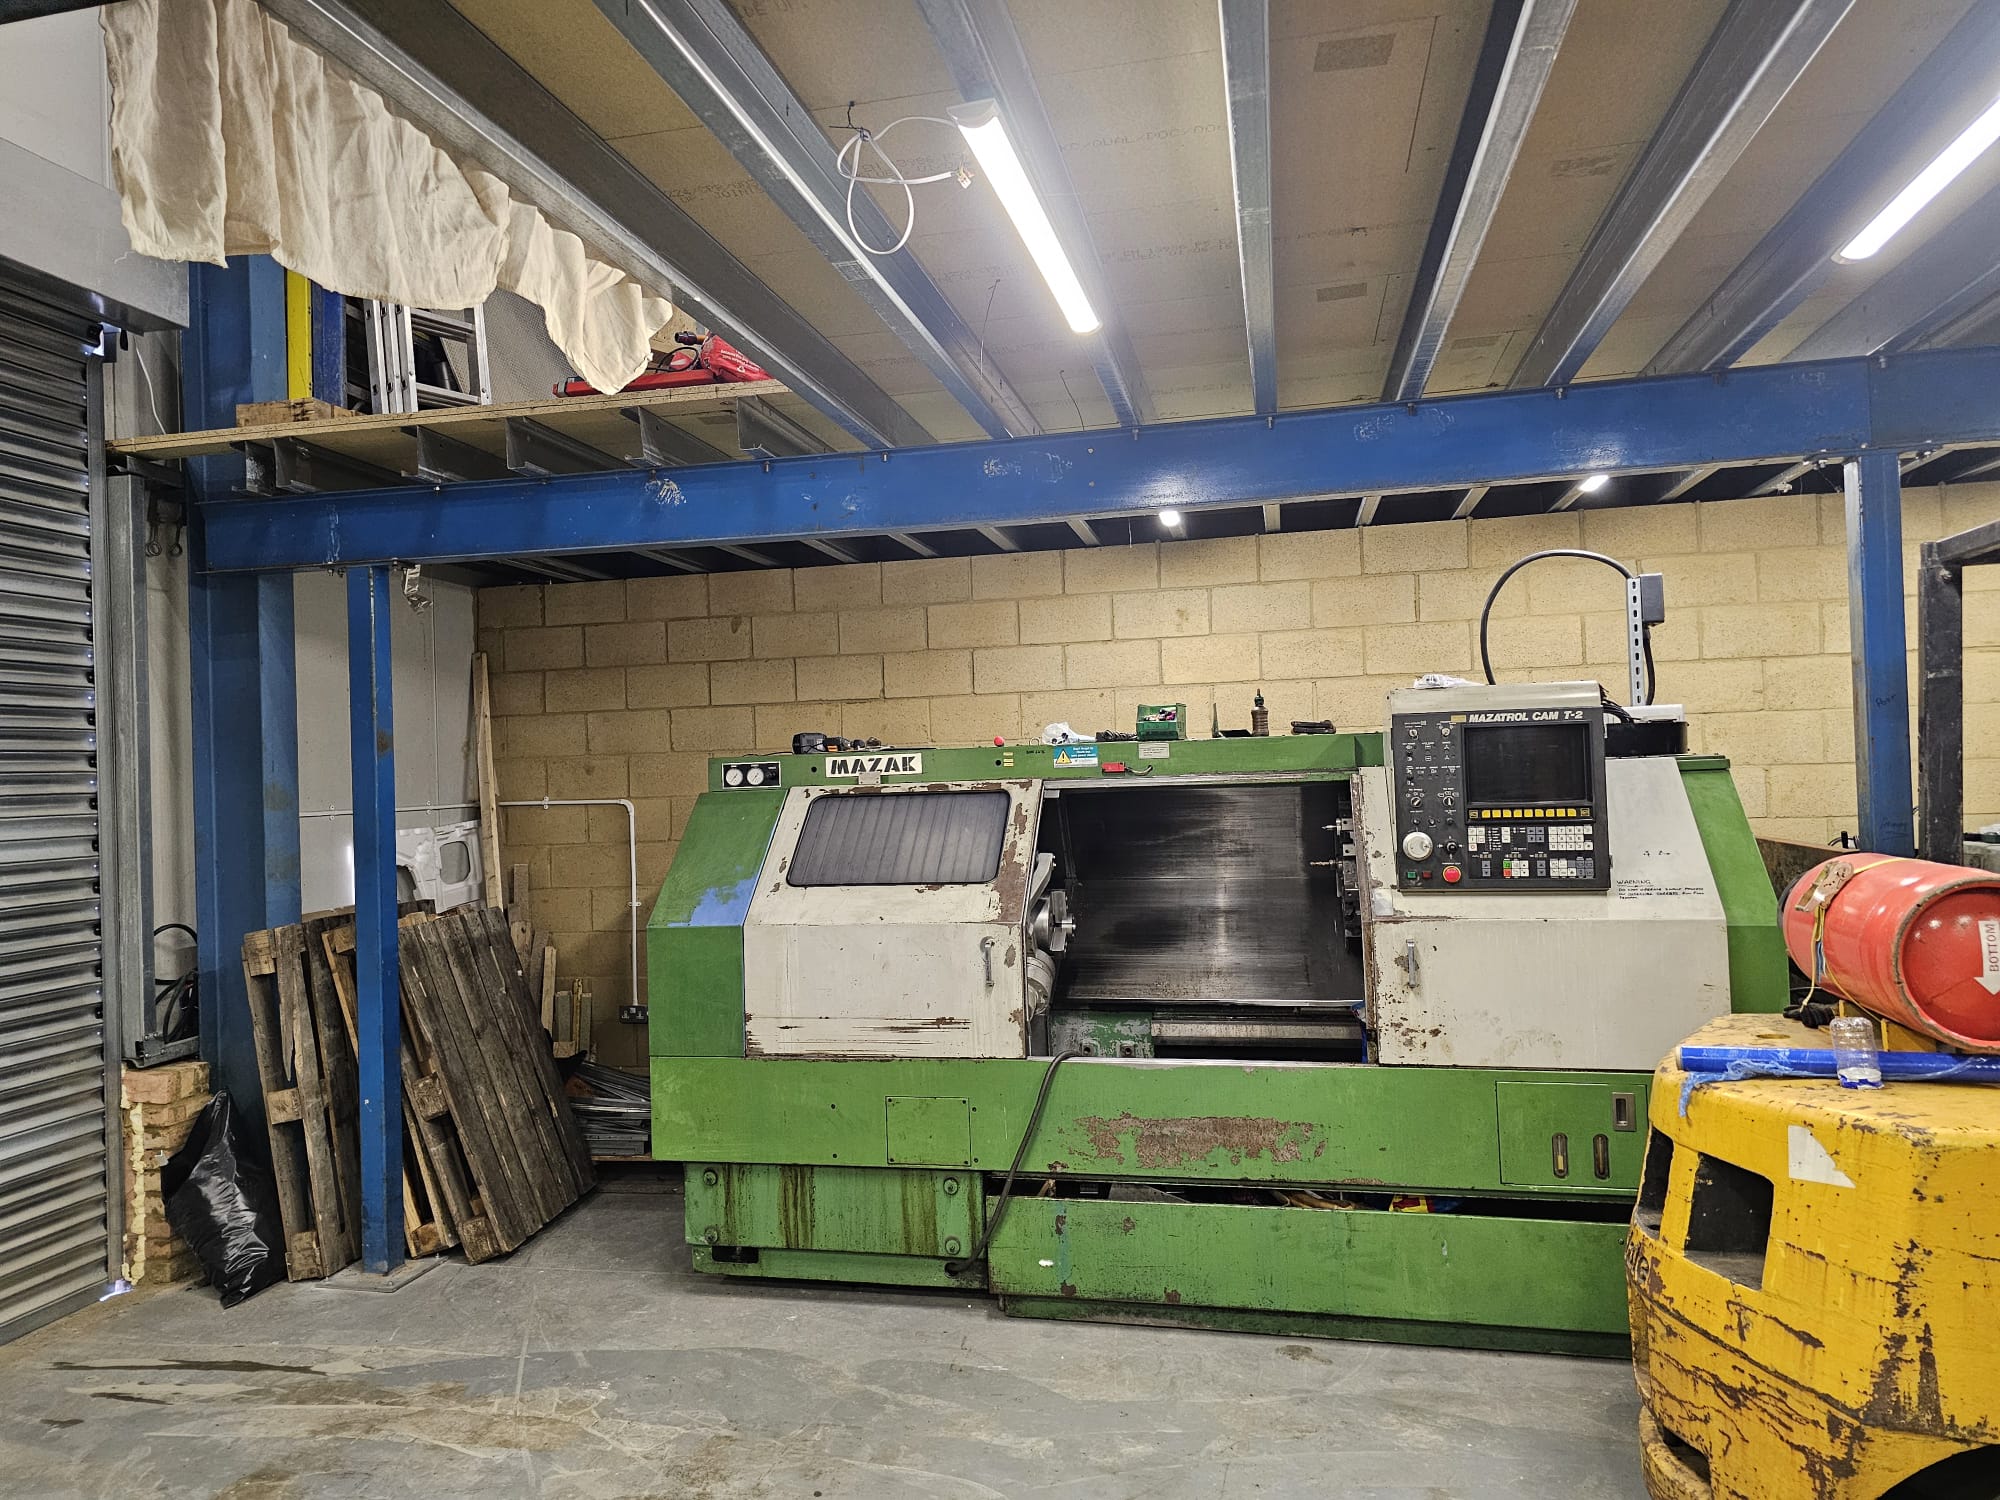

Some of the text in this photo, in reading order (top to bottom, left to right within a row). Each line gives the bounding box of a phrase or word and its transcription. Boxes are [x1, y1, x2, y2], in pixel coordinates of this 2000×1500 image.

[1469, 710, 1583, 723] MAZATROL CAM T-2
[830, 756, 916, 774] MAZAK
[1985, 923, 2000, 972] BOTTOM
